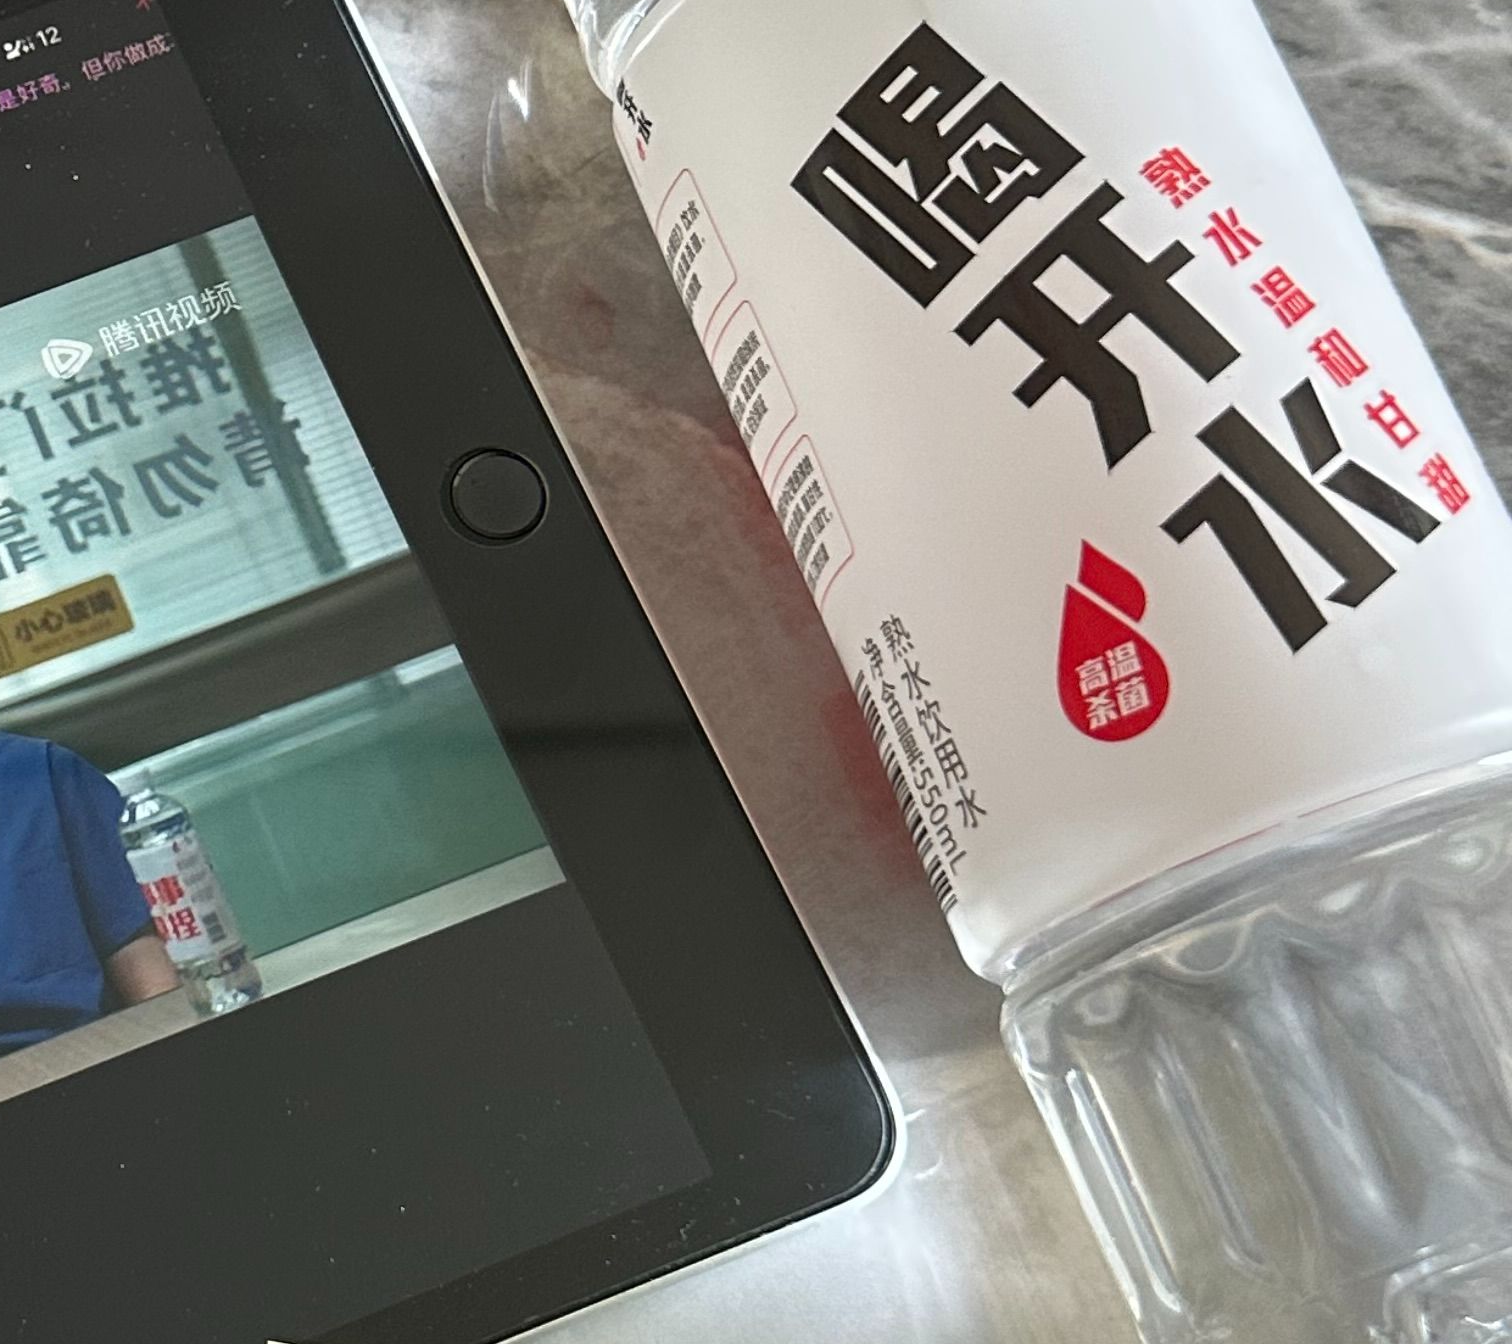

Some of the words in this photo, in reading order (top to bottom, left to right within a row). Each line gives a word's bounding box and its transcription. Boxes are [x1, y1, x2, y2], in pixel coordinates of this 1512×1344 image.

[36, 26, 62, 47] 12
[98, 280, 242, 358] 腾讯视频
[789, 19, 1441, 654] 喝开水
[1139, 146, 1472, 516] 熟水温和甘甜
[1075, 639, 1144, 697] 高温
[1084, 674, 1152, 731] 杀菌
[879, 613, 988, 829] 熟水饮用水
